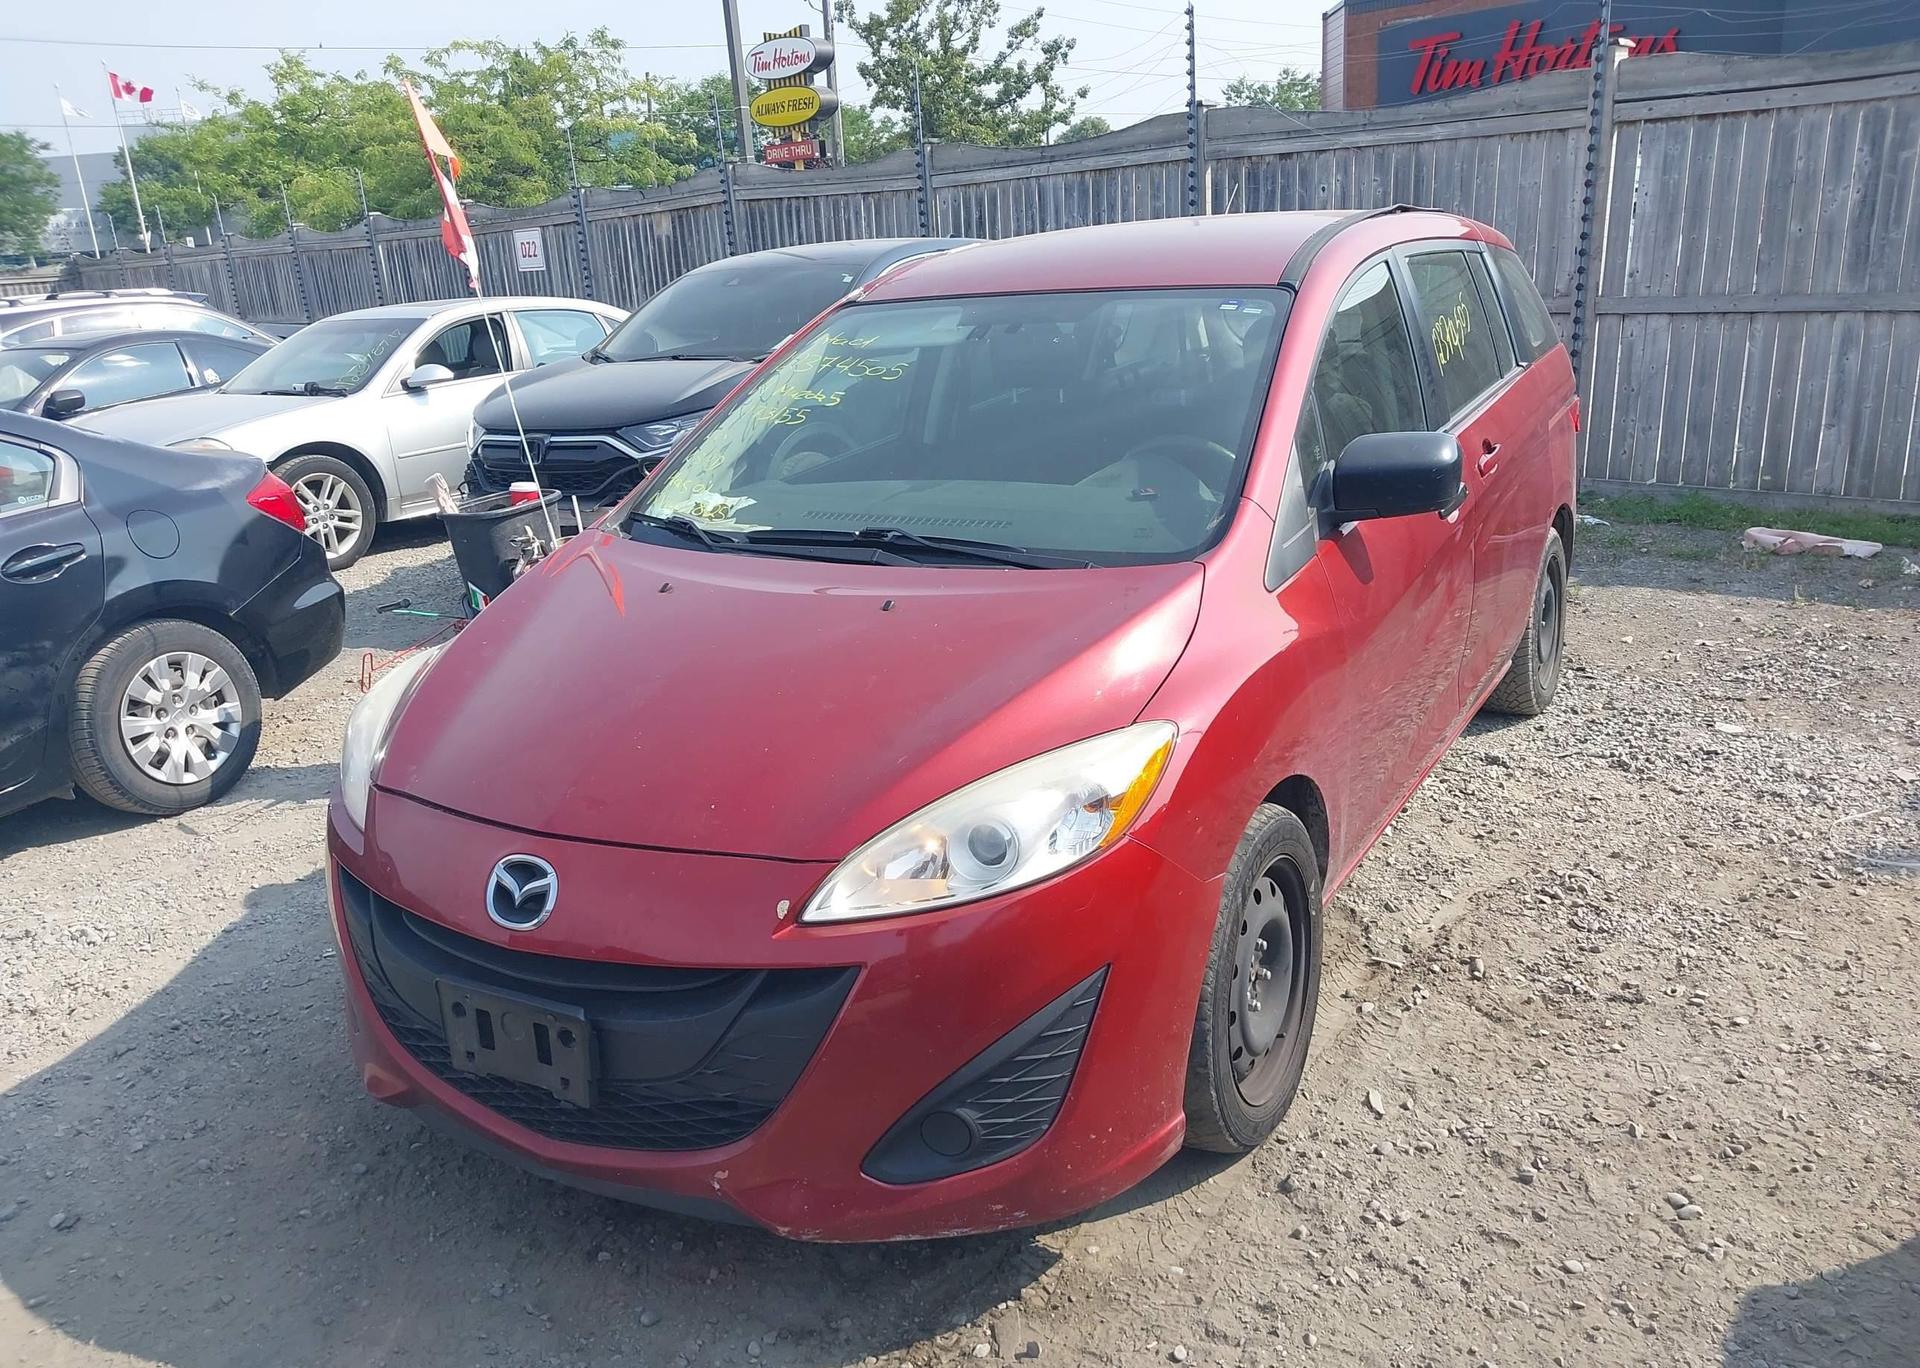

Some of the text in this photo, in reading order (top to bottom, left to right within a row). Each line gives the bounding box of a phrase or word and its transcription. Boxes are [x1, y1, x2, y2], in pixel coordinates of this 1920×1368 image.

[751, 47, 811, 74] Tim Hortons
[1408, 18, 1681, 96] Tim Hortns
[755, 96, 814, 117] ALWAYS FRESH
[766, 143, 812, 160] DRIVE THRU
